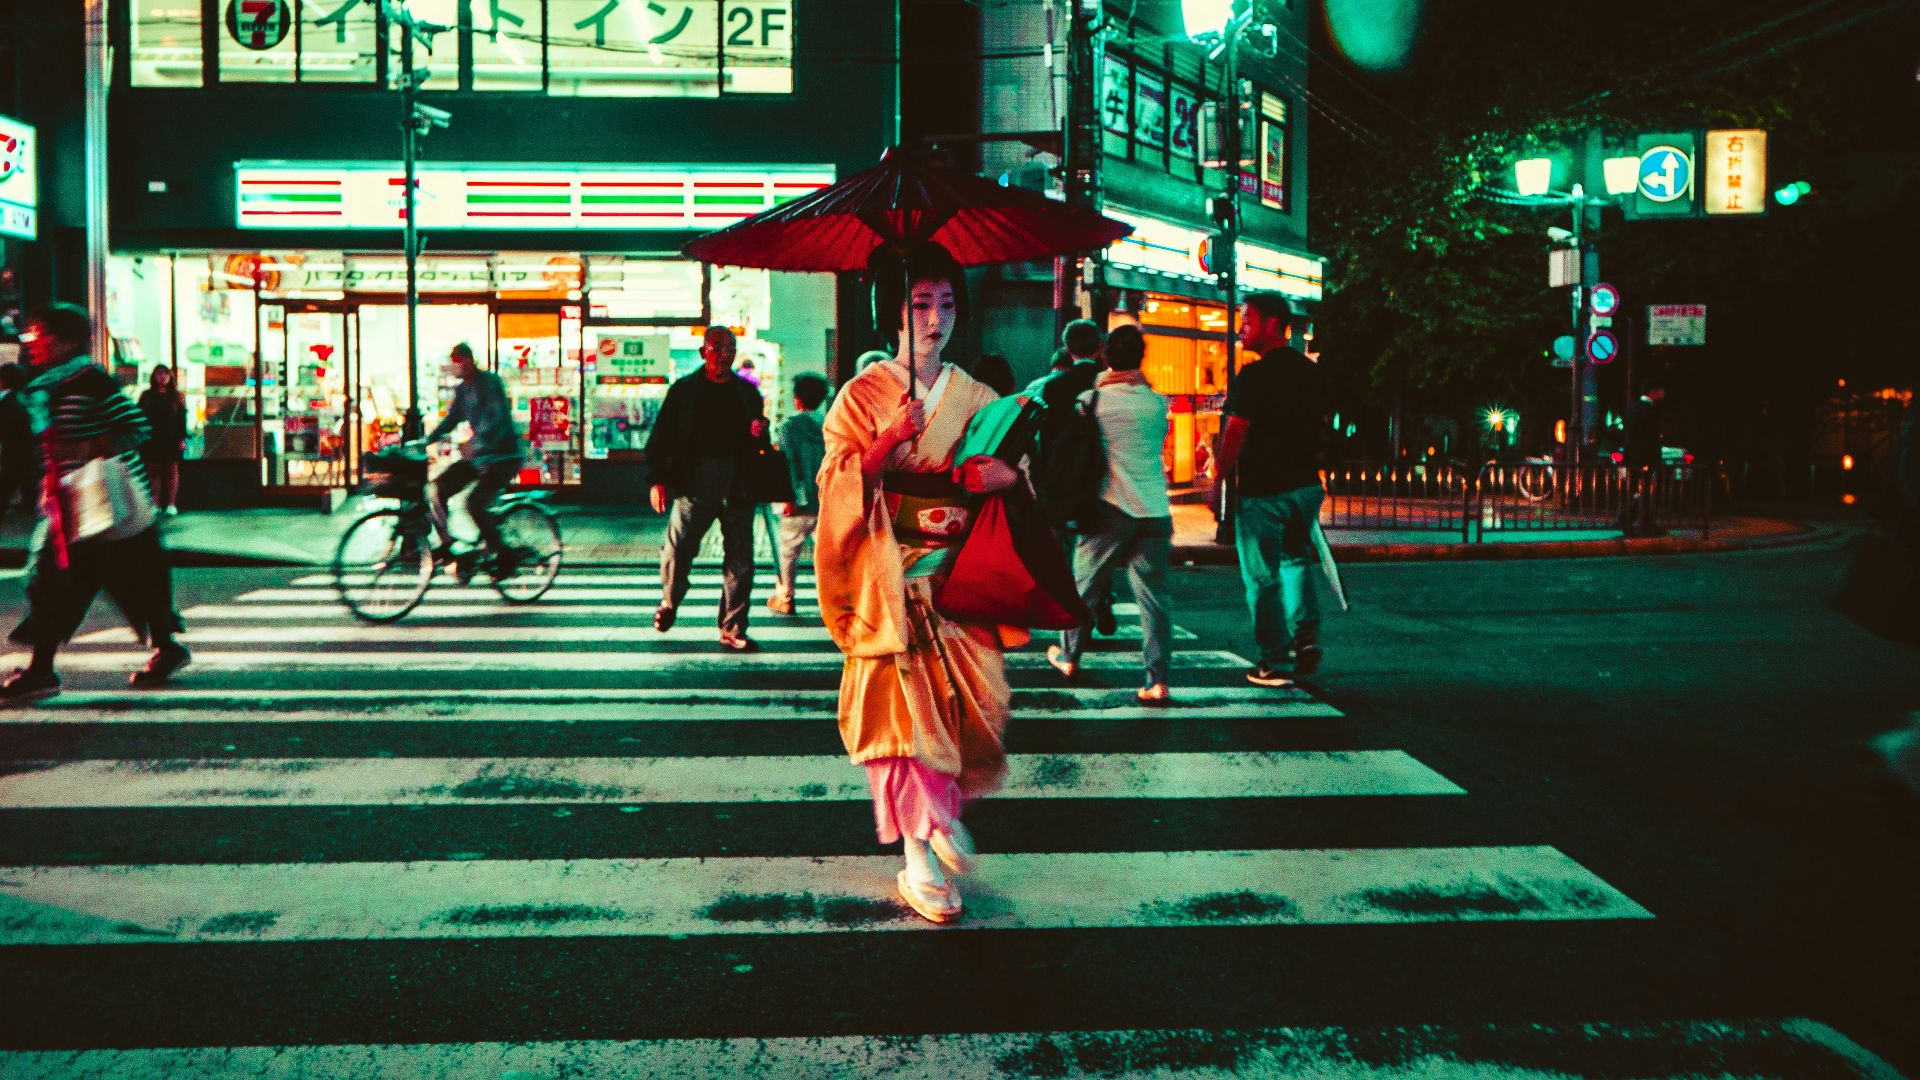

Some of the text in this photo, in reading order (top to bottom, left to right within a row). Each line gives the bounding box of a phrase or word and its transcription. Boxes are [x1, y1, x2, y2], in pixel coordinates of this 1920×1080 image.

[241, 1, 275, 46] 7
[726, 7, 787, 46] 2F
[1727, 135, 1744, 210] 右折禁止
